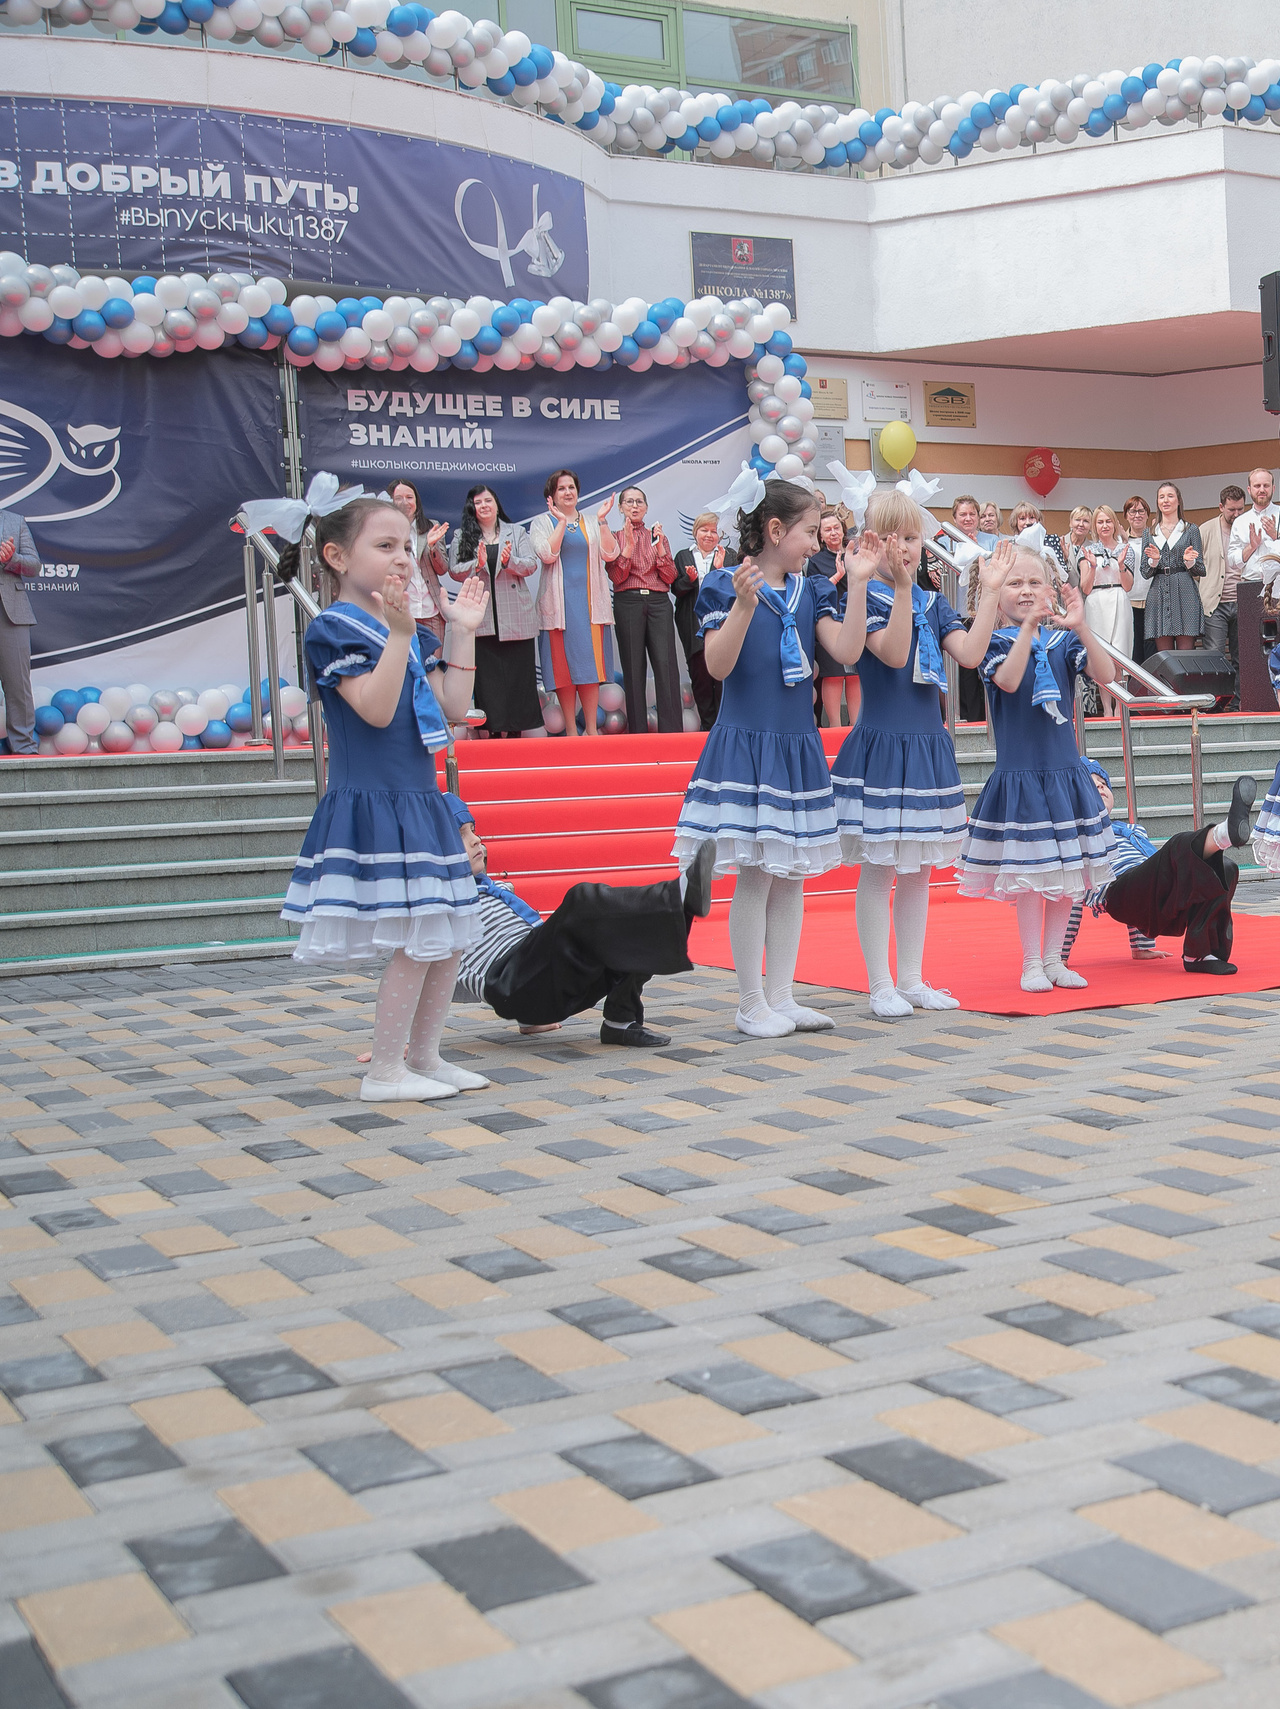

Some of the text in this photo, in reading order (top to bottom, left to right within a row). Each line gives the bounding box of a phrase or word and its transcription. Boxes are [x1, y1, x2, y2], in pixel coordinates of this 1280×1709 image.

[31, 161, 232, 199] ДОБРЫЙ
[246, 174, 360, 213] ПУТЬ!
[697, 285, 792, 301] «ШКОЛА №1387»
[347, 389, 622, 421] БУДУЩЕЕ В СИЛЕ
[348, 421, 494, 450] ЗНАНИЙ!
[350, 459, 517, 473] #ШКОЛЫКОЛЛЕДЖИМОСКВЫ
[37, 582, 80, 592] ЗНАНИЙ
